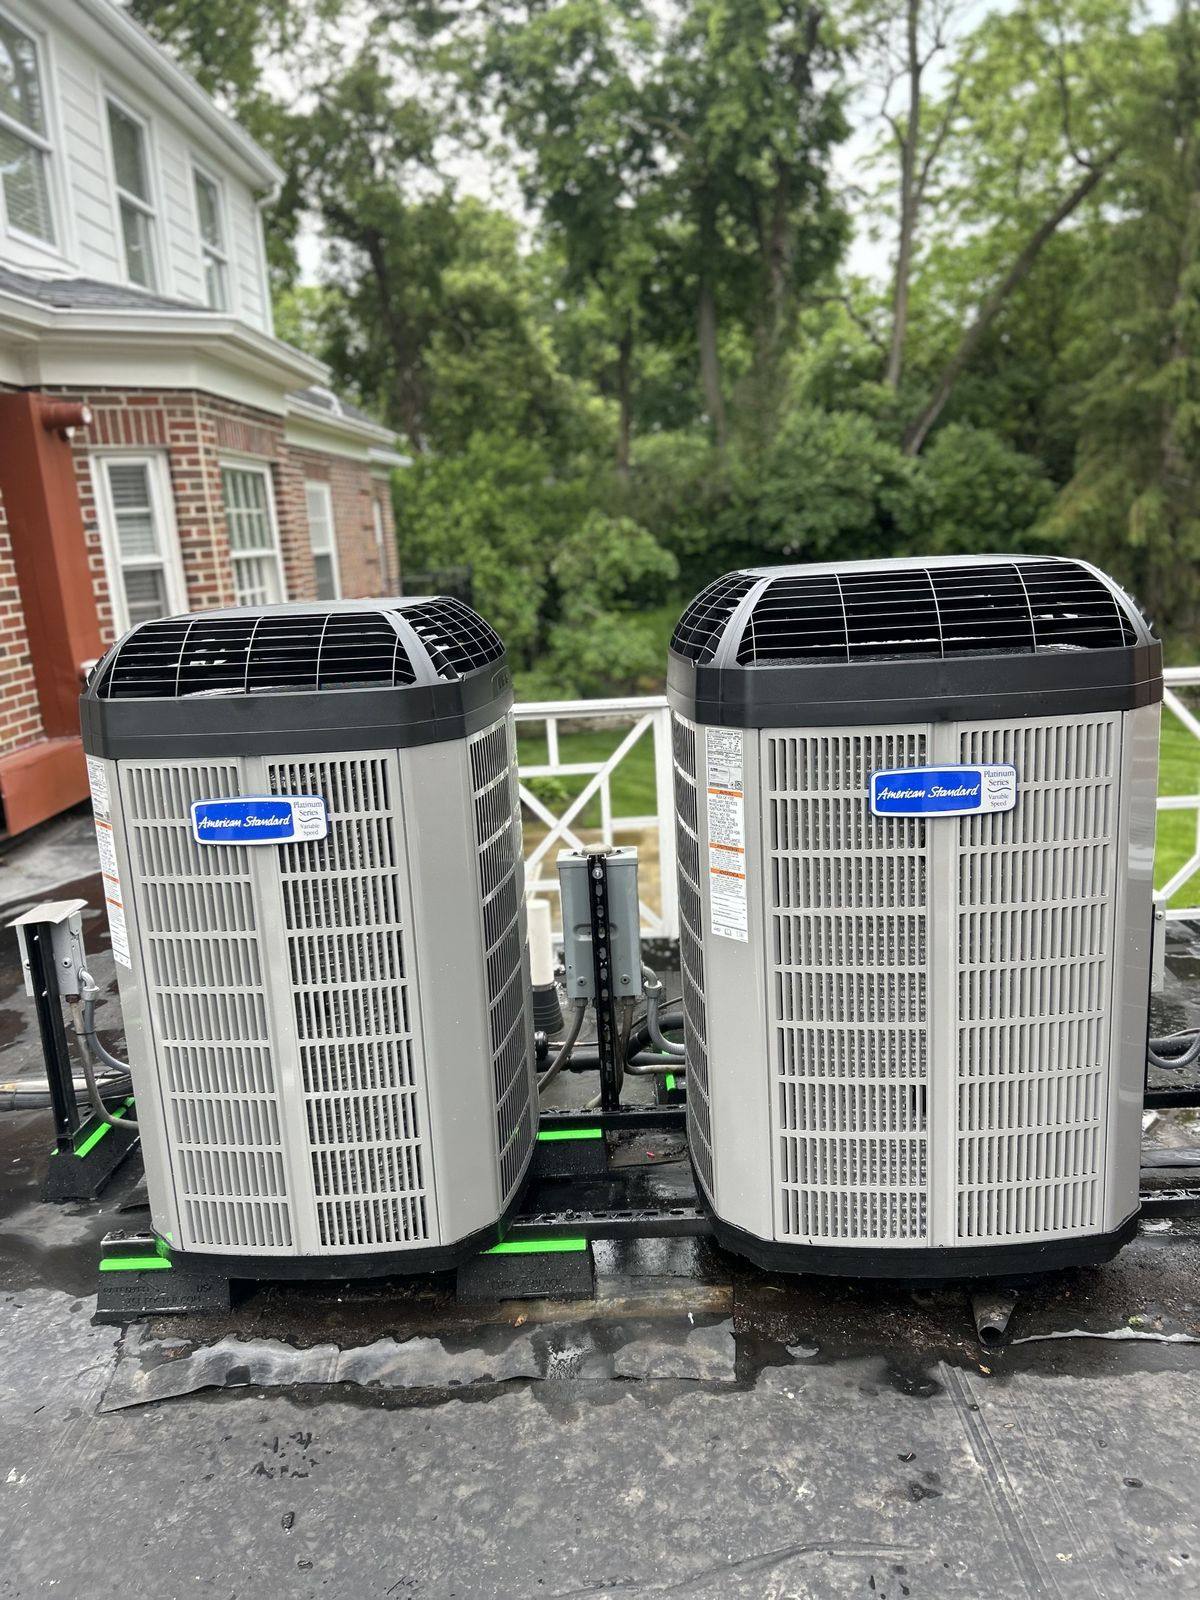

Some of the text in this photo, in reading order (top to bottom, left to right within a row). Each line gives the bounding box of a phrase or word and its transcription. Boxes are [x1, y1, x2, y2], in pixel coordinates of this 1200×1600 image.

[983, 769, 1015, 778] Platinum
[877, 784, 980, 800] American Standard
[293, 801, 323, 809] Platinum
[990, 800, 1007, 808] Speed
[198, 814, 292, 828] American Standard
